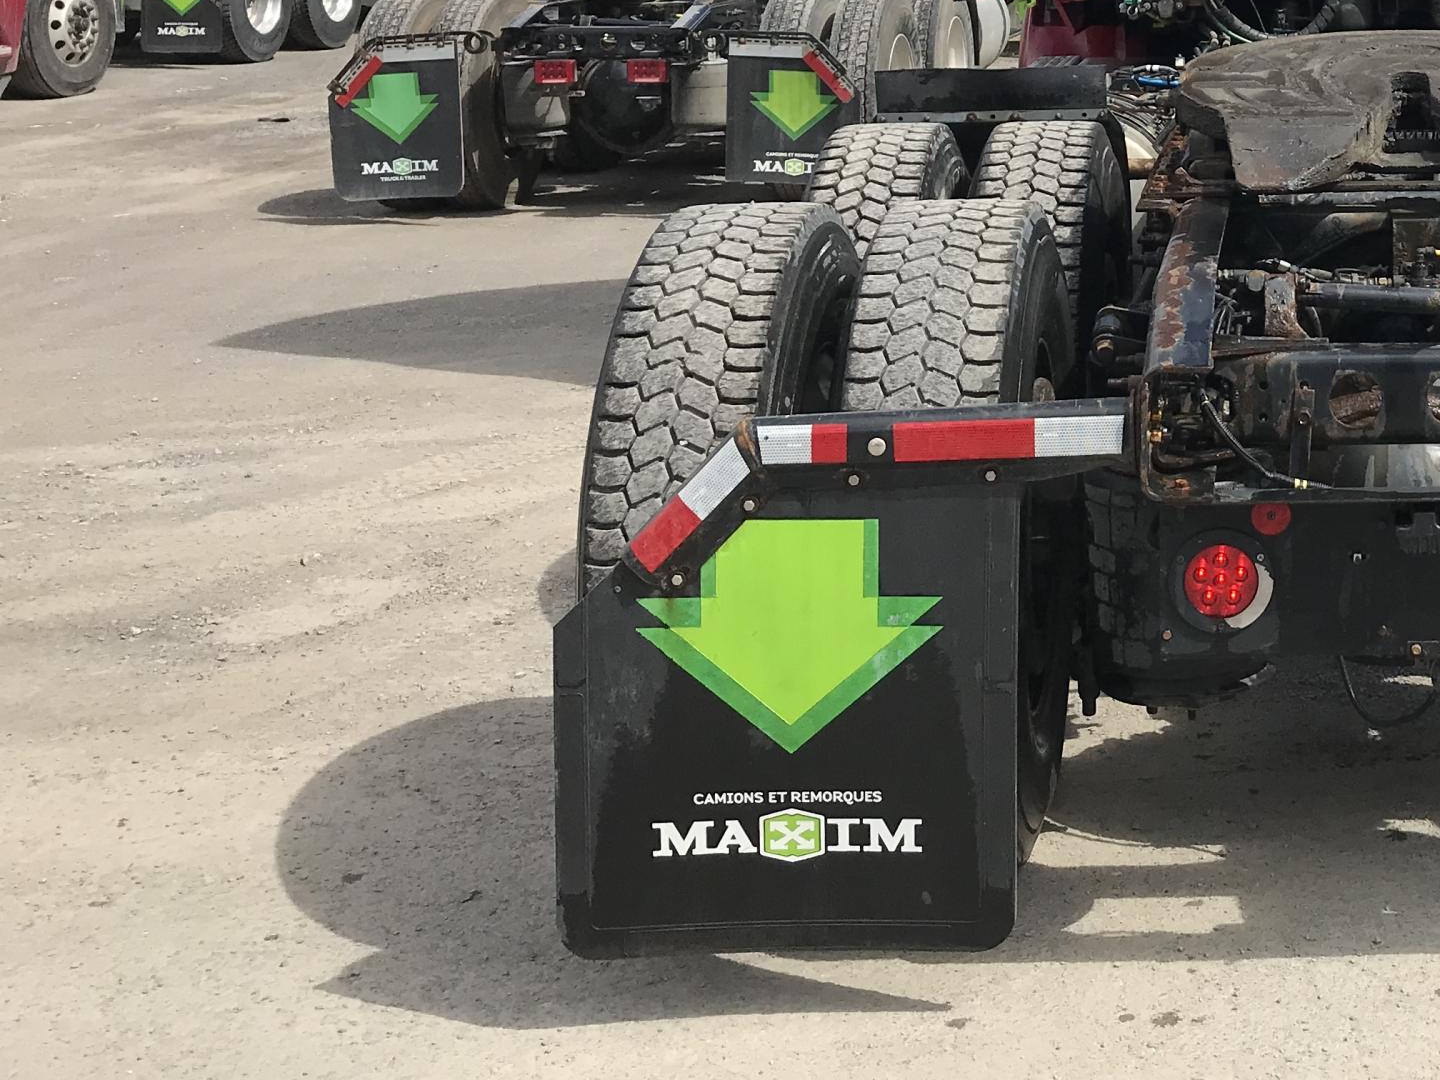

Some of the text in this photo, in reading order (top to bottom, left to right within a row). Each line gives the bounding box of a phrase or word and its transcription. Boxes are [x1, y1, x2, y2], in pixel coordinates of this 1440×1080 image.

[157, 25, 206, 37] MAXIM
[360, 157, 439, 176] MAXIM
[752, 158, 815, 176] MAXI
[693, 790, 883, 805] CAMIONS ET REMORQUES
[651, 808, 923, 863] MAXIM
